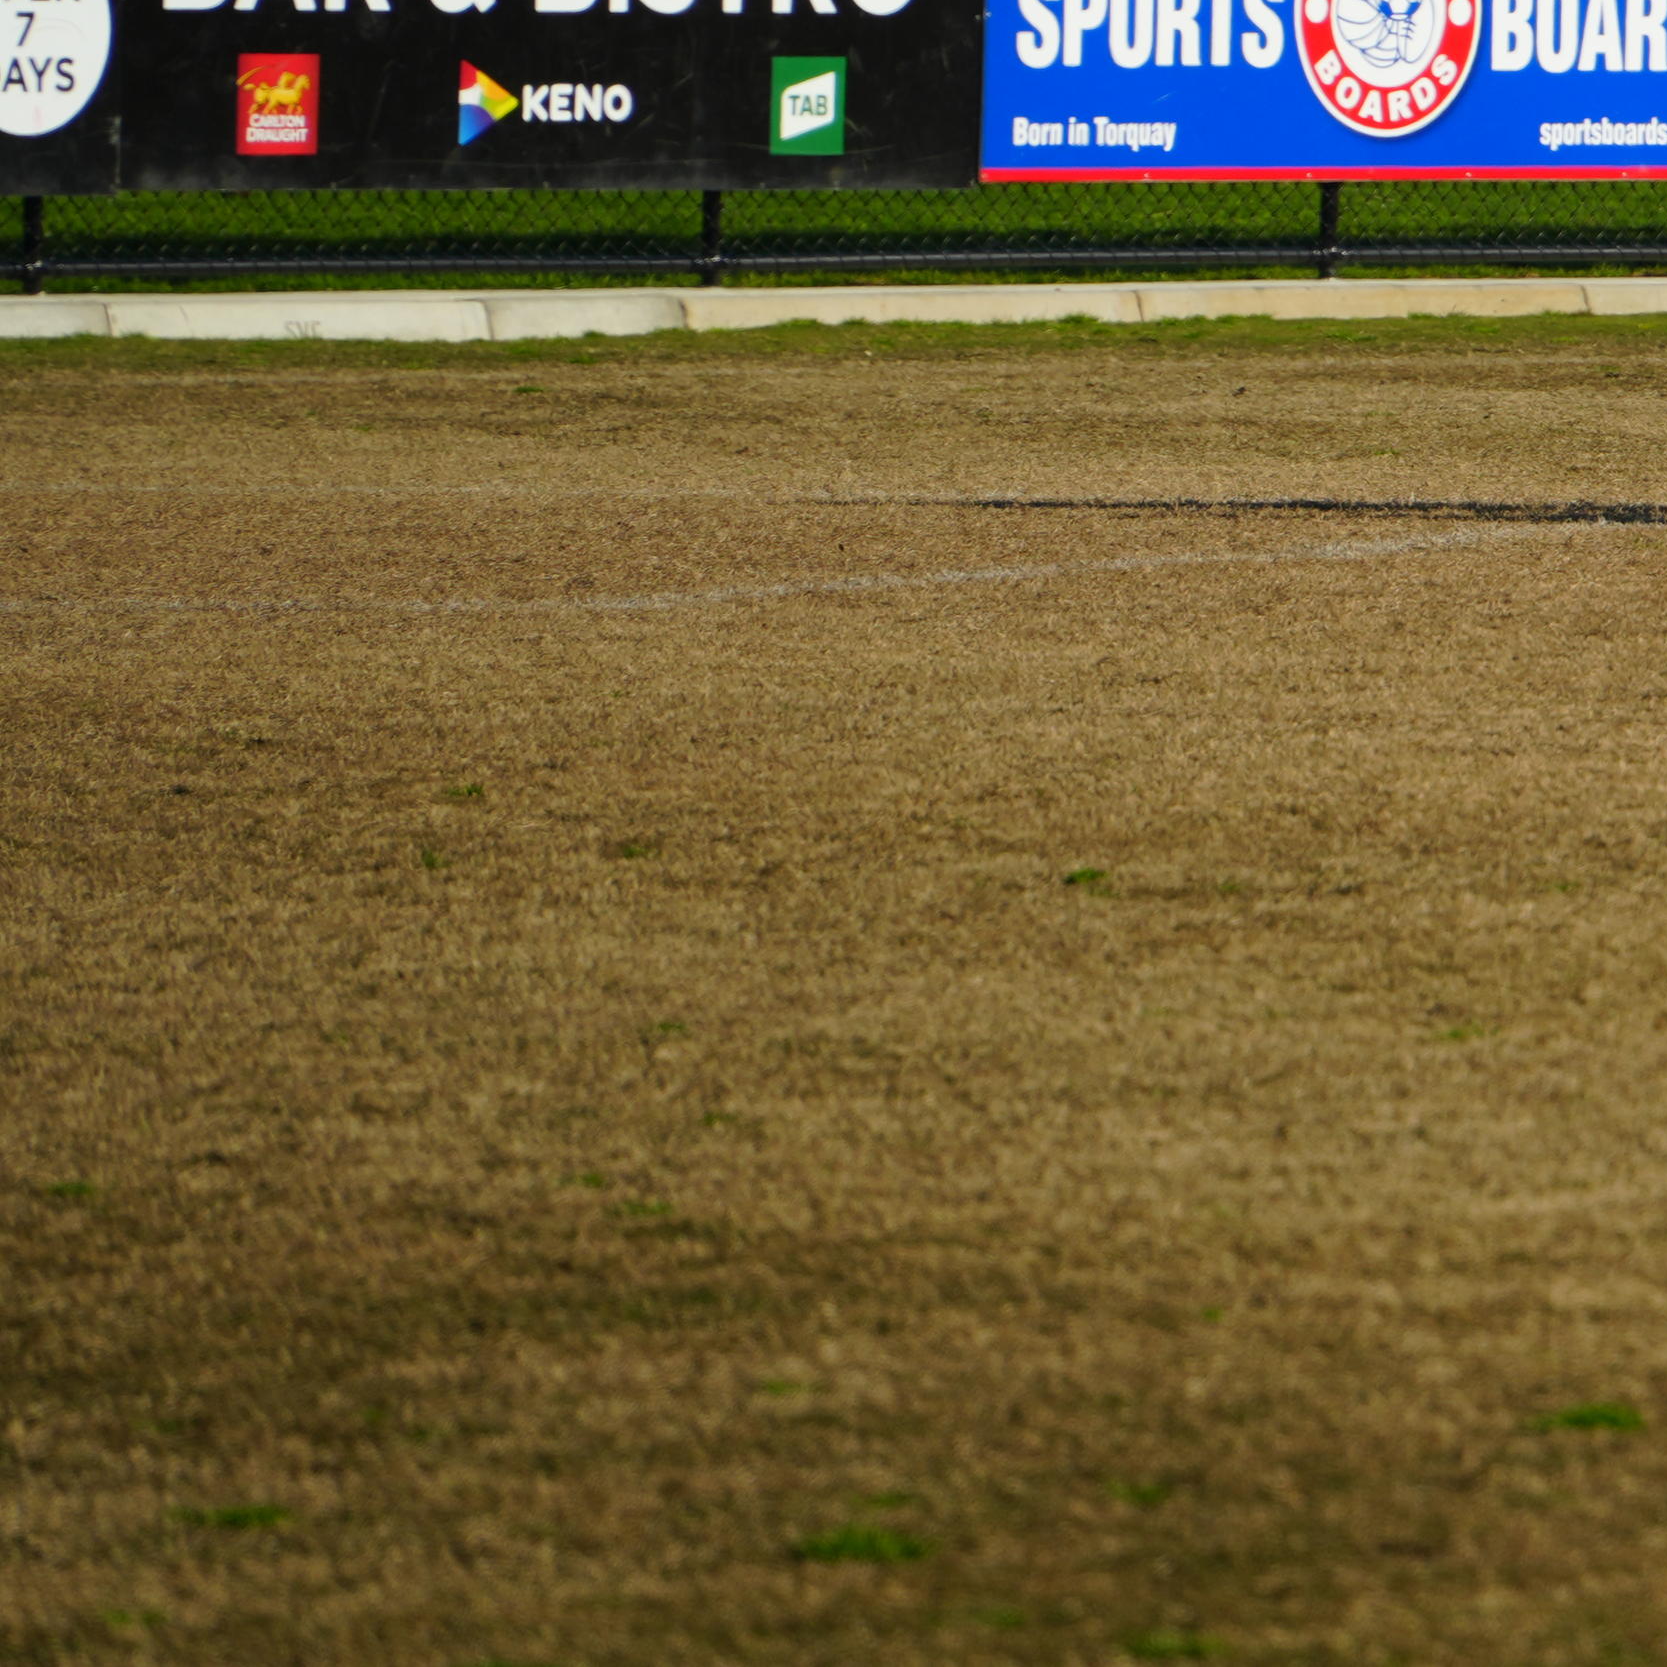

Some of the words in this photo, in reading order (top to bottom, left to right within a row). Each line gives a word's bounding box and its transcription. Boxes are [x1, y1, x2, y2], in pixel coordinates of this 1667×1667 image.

[17, 12, 34, 46] 7
[2, 58, 74, 93] AYS
[1314, 50, 1458, 123] BOARDS
[522, 83, 632, 122] KENO
[789, 95, 827, 116] TAB
[1013, 117, 1063, 146] Born
[1068, 117, 1090, 146] in
[1093, 116, 1176, 152] Torquay
